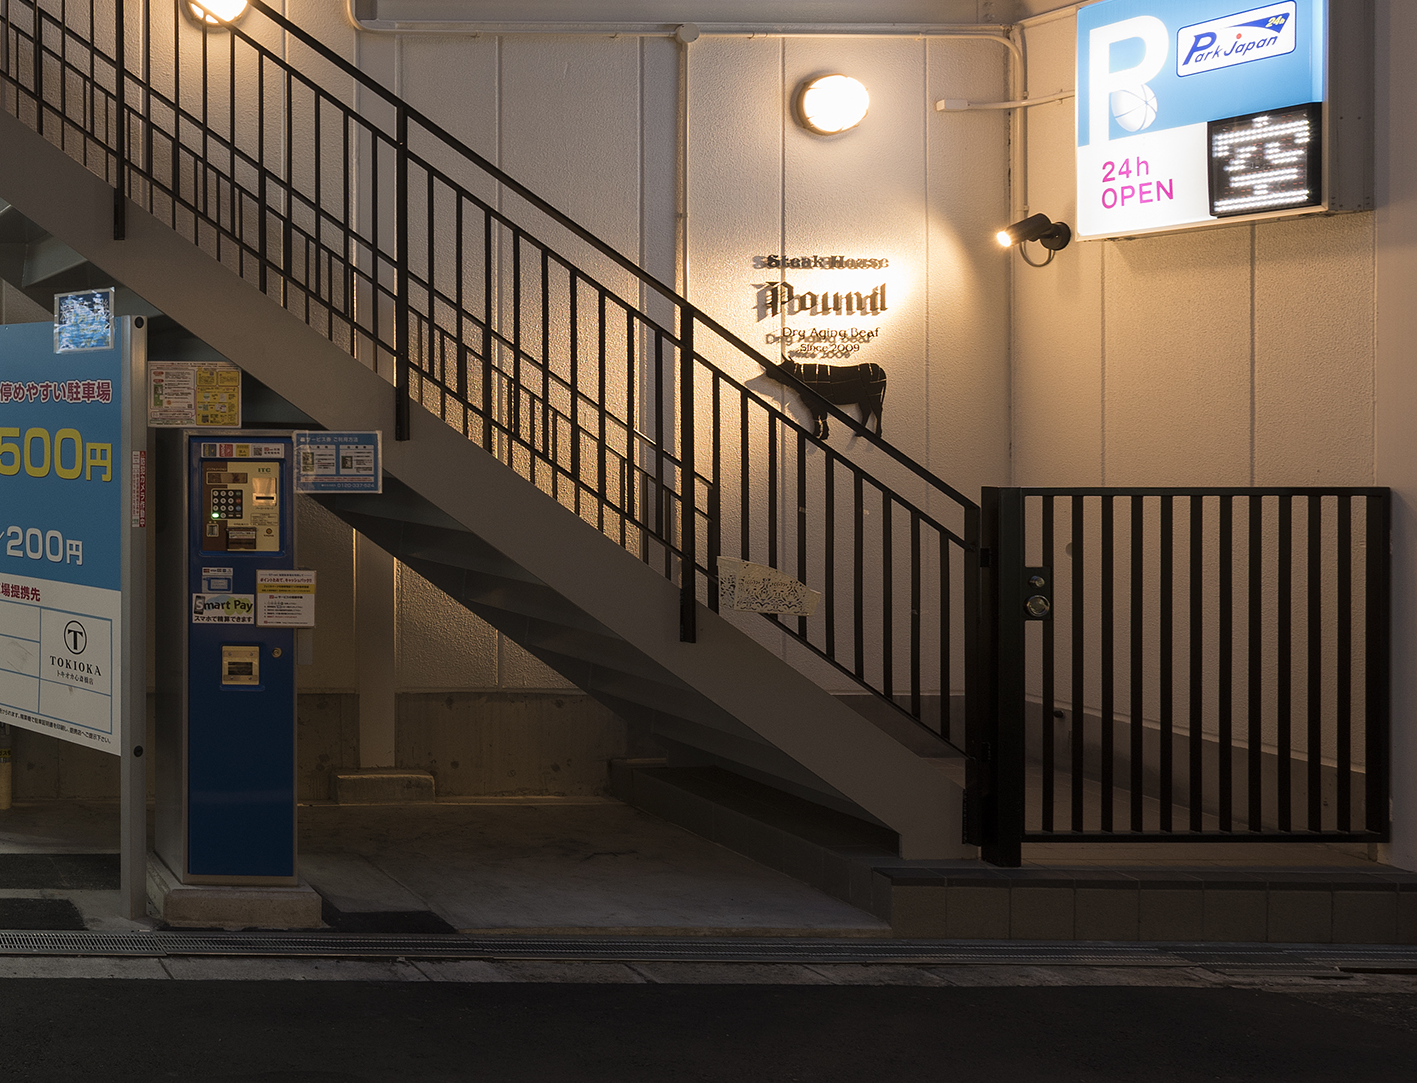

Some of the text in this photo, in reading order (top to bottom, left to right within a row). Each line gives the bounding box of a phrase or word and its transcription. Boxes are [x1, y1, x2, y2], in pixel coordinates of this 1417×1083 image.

[1182, 31, 1223, 66] Park
[1223, 33, 1278, 58] Japan
[1101, 157, 1149, 183] 24h
[1101, 179, 1174, 209] OPEN
[767, 254, 889, 269] Steak House
[765, 280, 889, 317] Pound
[782, 326, 805, 340] Dry
[810, 326, 847, 340] Aging
[799, 343, 860, 352] Since 2009
[0, 381, 112, 403] 停めやすい駐車場
[195, 599, 231, 611] Smart
[234, 600, 253, 613] Pay
[49, 655, 102, 677] TOKIOKA
